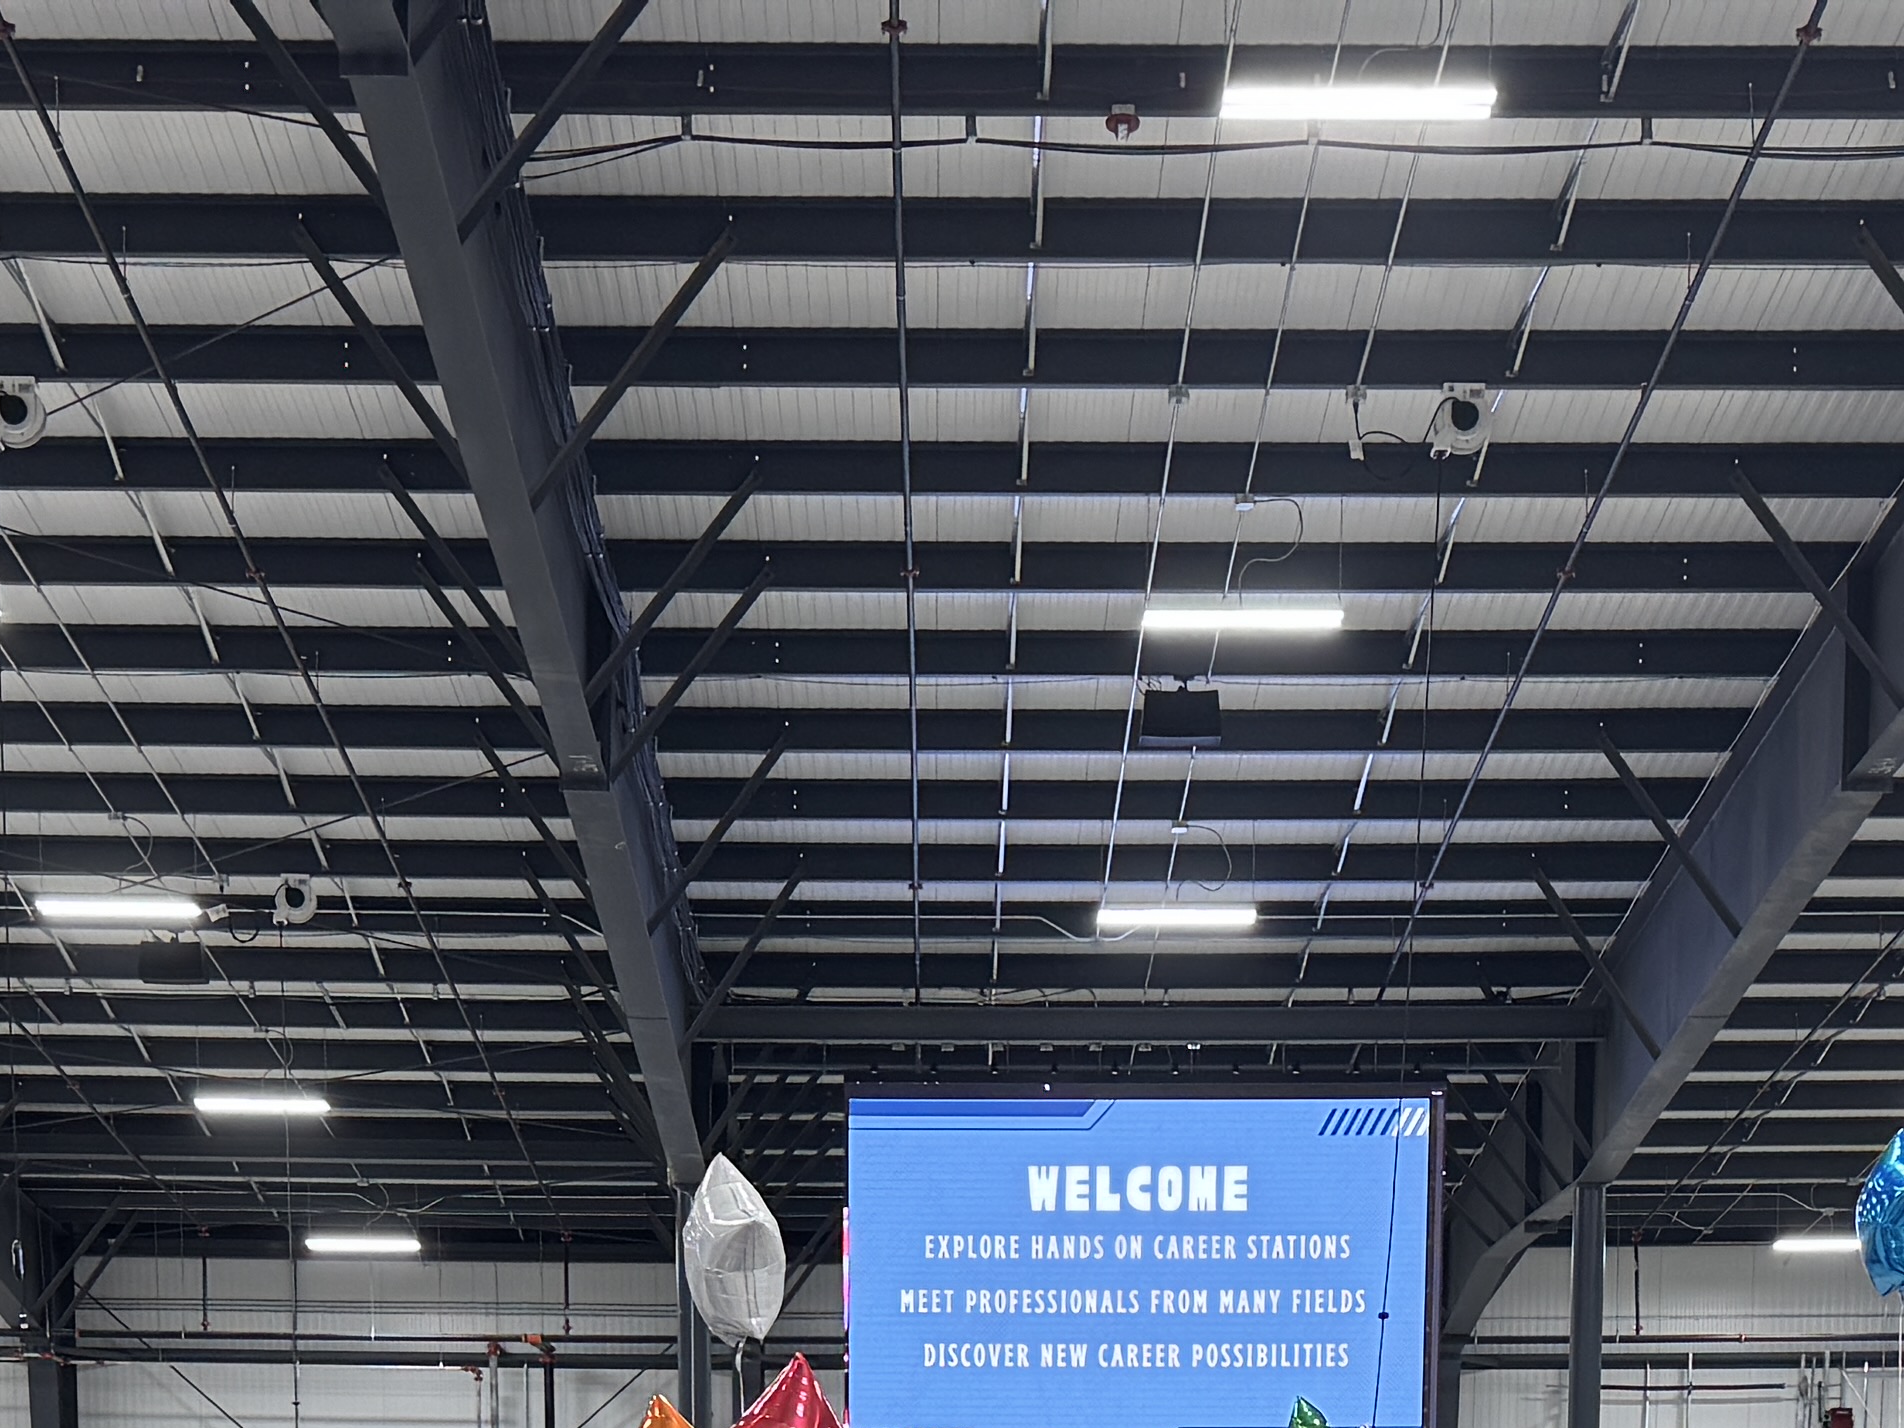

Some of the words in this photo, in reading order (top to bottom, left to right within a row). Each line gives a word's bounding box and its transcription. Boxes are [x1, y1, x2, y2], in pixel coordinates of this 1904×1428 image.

[1028, 1165, 1249, 1212] WELCOME
[924, 1234, 1020, 1260] EXPLORE
[1030, 1234, 1104, 1260] HANDS
[1114, 1234, 1143, 1260] ON
[1153, 1234, 1237, 1260] CAREER
[1246, 1234, 1351, 1260] STATIONS
[899, 1288, 954, 1315] MEET
[965, 1288, 1140, 1315] PROFESSIONALS
[1150, 1288, 1207, 1315] FROM
[1219, 1288, 1280, 1315] MANY
[1292, 1288, 1366, 1315] FIELDS
[922, 1342, 1029, 1369] DISCOVER
[1039, 1342, 1087, 1369] NEW
[1097, 1342, 1181, 1369] CAREER
[1191, 1342, 1350, 1369] POSSIBILITIES
